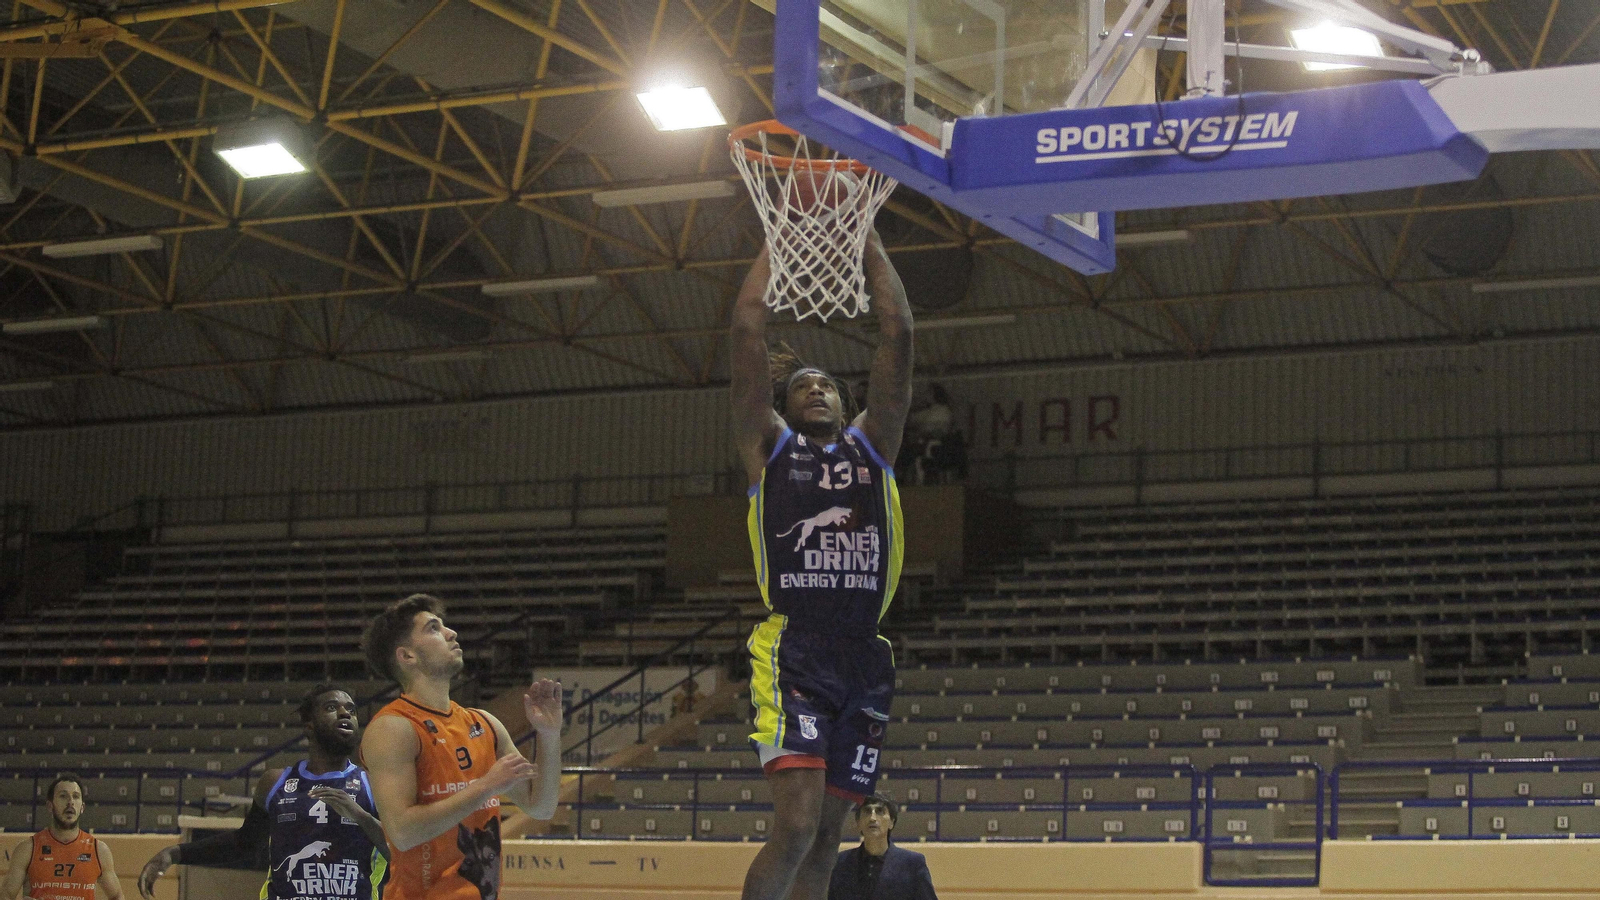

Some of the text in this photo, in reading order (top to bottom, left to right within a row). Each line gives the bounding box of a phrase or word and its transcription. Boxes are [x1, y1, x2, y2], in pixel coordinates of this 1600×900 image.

[818, 460, 853, 490] 13
[820, 531, 880, 553] ENER
[804, 550, 880, 573] DRINK
[780, 573, 840, 589] ENERGY
[455, 746, 473, 770] 9
[851, 744, 879, 774] 13
[308, 799, 329, 824] 4
[54, 863, 75, 877] 27
[303, 862, 359, 880] ENER
[637, 857, 662, 872] TV
[292, 879, 358, 896] DRINK
